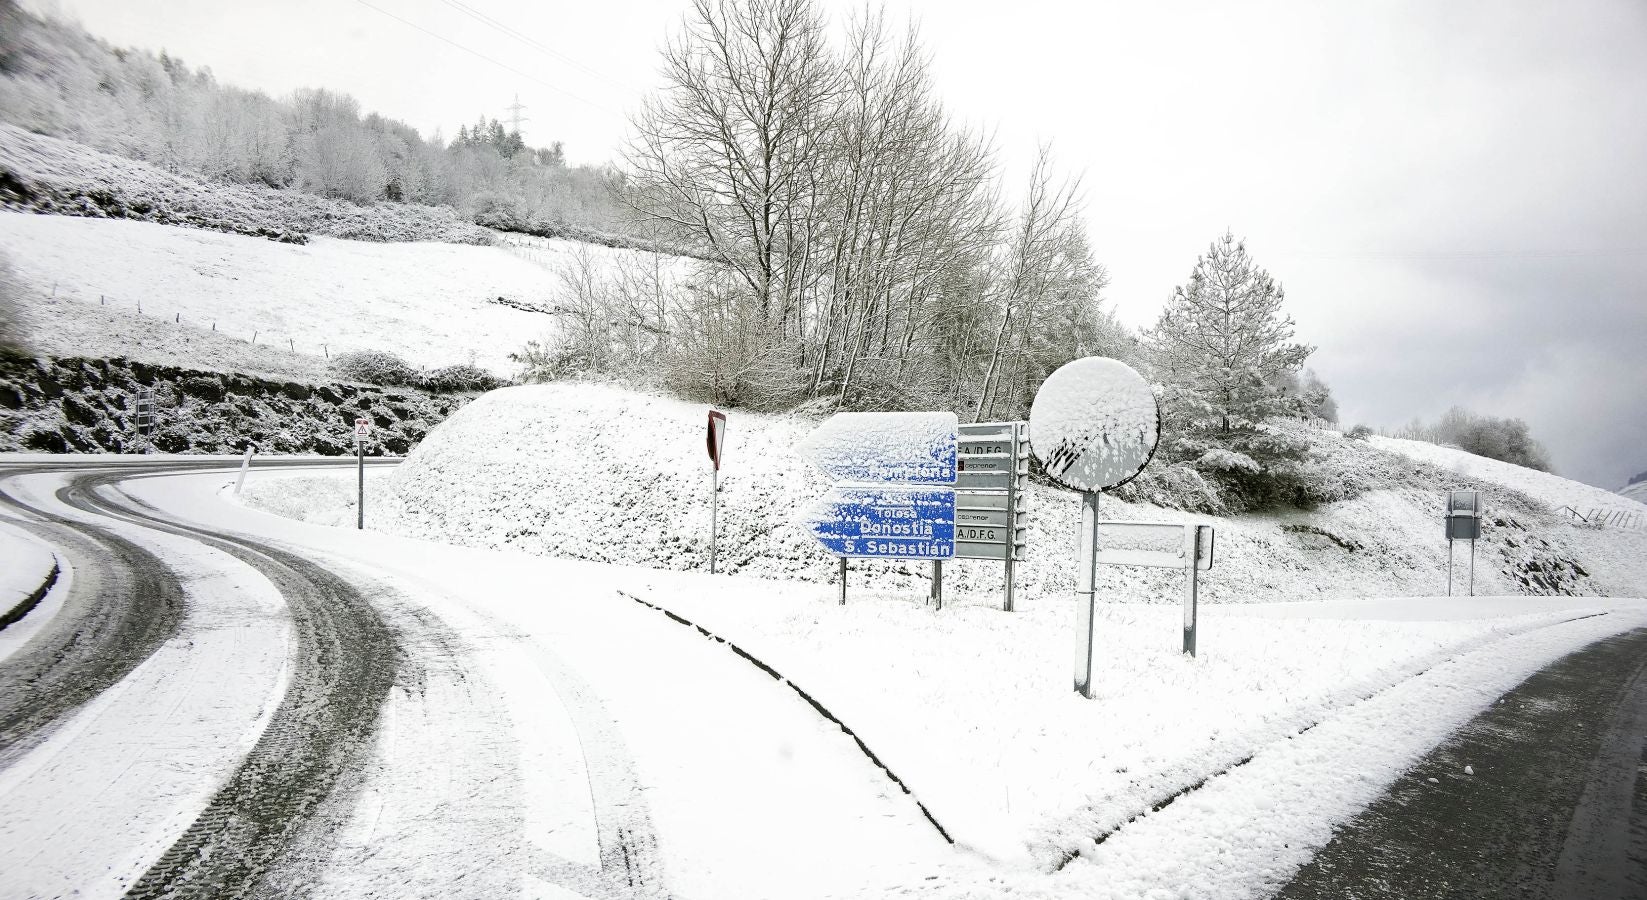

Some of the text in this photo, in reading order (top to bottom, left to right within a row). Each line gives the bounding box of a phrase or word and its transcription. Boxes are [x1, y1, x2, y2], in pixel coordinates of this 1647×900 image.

[876, 508, 918, 519] Tolosa
[860, 520, 933, 535] Donostia
[866, 540, 950, 556] Sebastián
